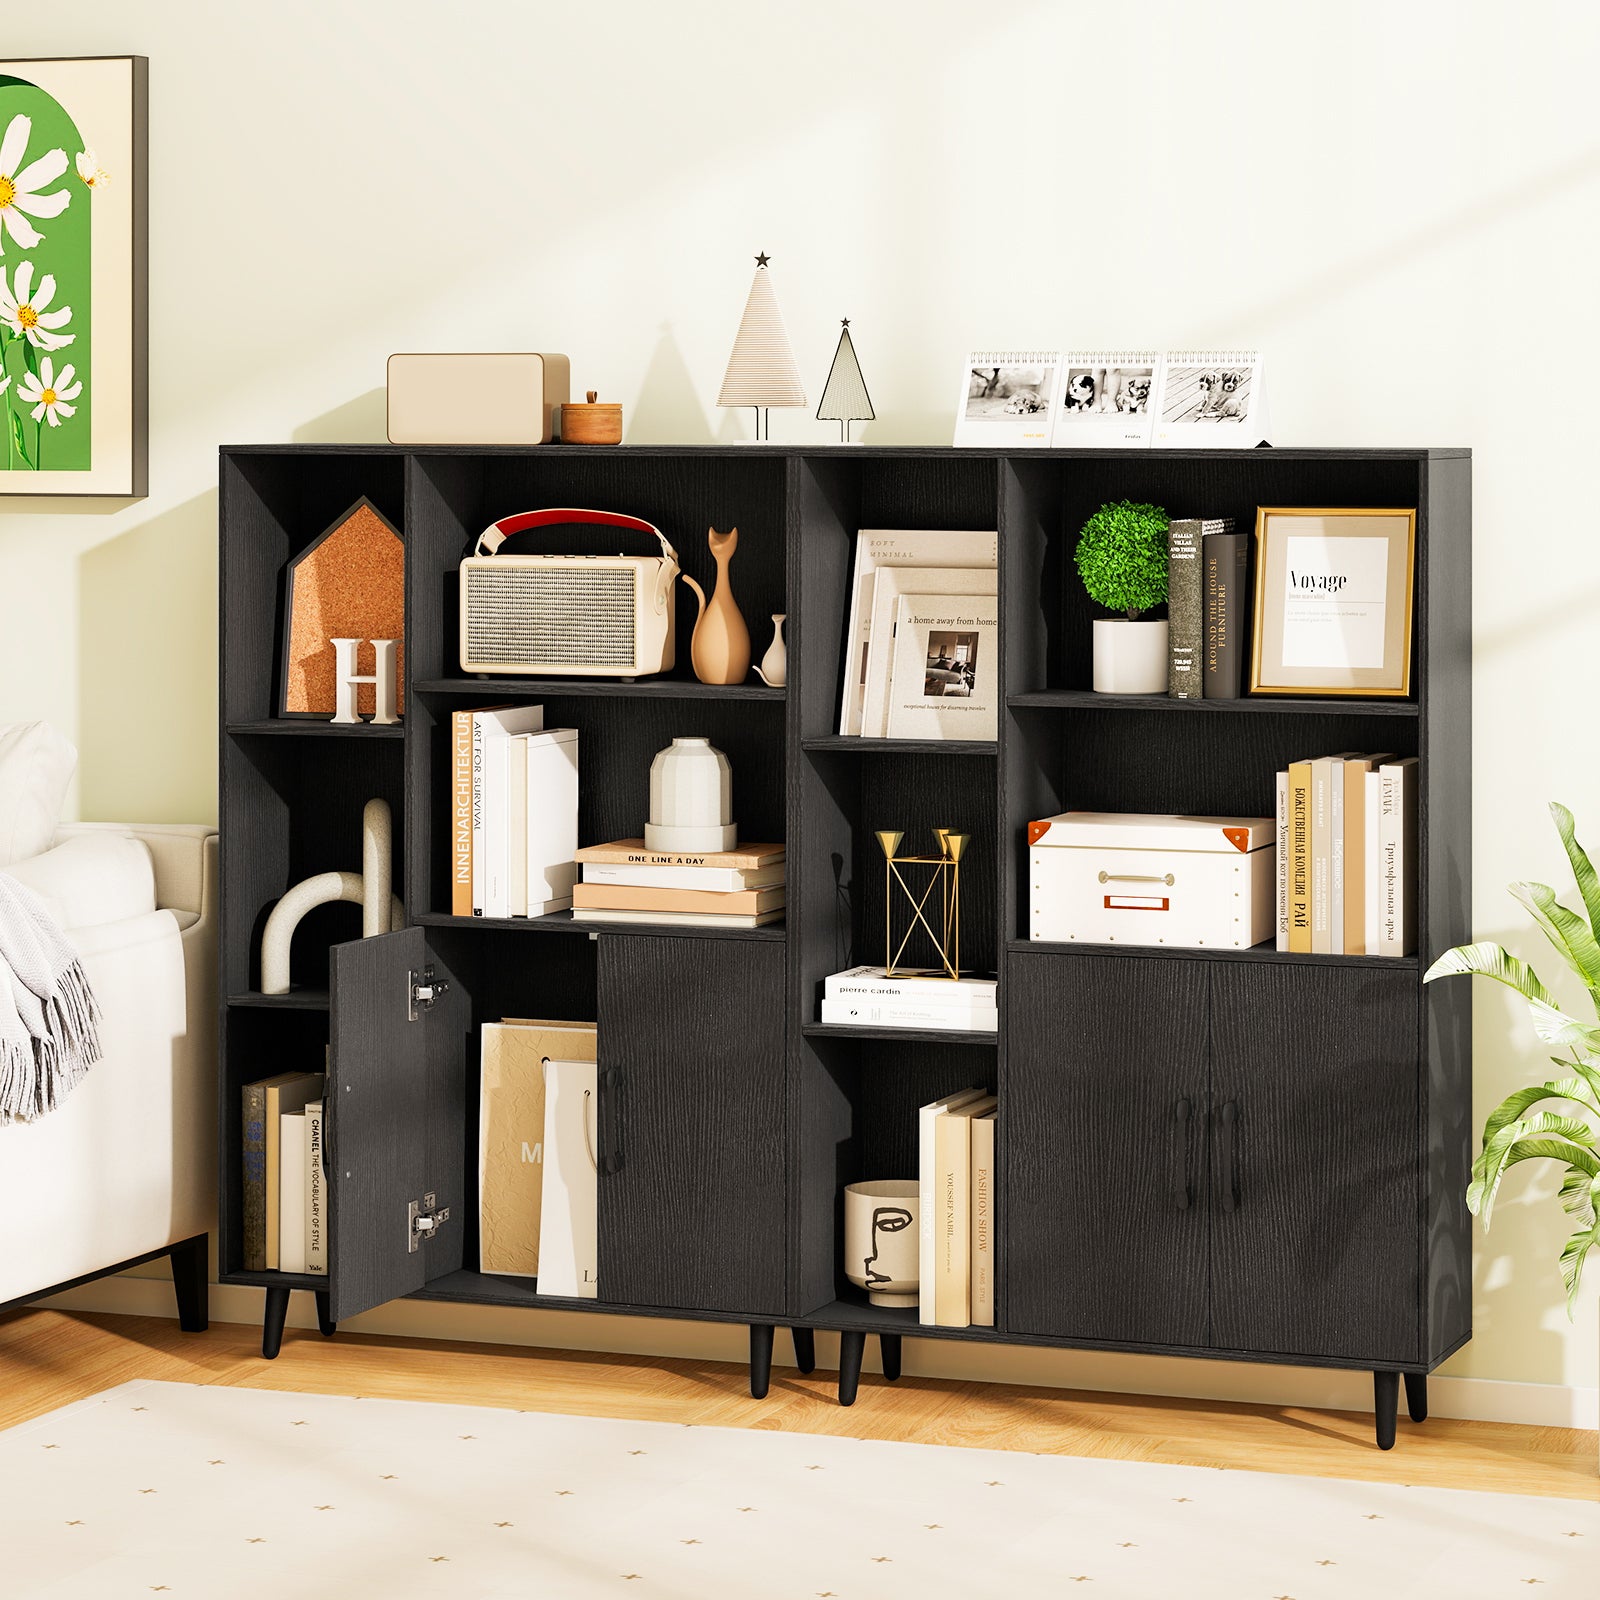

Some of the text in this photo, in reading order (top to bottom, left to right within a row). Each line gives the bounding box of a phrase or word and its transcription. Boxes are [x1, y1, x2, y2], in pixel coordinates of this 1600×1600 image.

[1290, 570, 1347, 592] Voyage
[914, 616, 934, 624] home
[936, 618, 955, 626] away
[956, 617, 974, 625] from
[330, 638, 402, 724] H
[457, 713, 469, 884] INNENARCHITEKTUR
[1295, 788, 1308, 928] БОЖЕСТВЕННАЯ КОМЕДИЯ РАЙ
[1385, 842, 1396, 941] Триумфальная арка
[1280, 917, 1288, 933] Боб
[312, 1218, 319, 1228] OF
